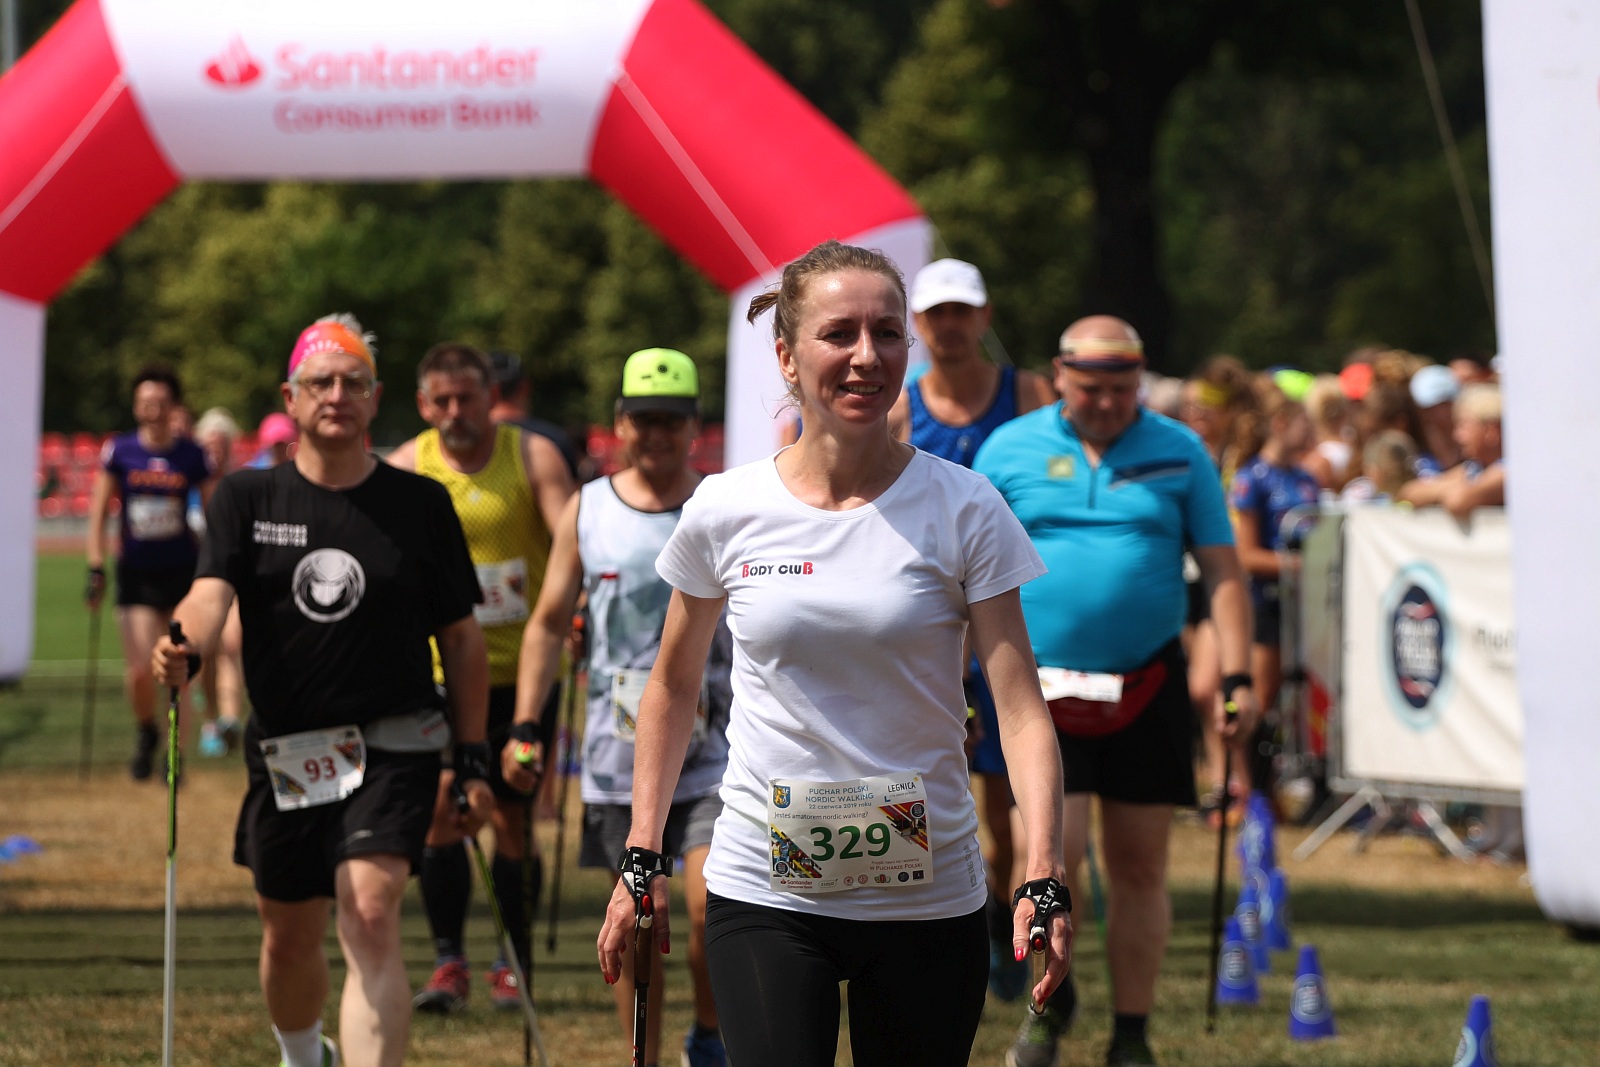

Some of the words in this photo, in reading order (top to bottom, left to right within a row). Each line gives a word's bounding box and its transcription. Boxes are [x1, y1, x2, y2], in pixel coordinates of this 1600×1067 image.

[274, 42, 540, 90] Santander
[273, 99, 447, 132] Consumer
[452, 98, 539, 131] Bank
[303, 756, 337, 783] 93
[838, 793, 874, 802] WALKING
[843, 785, 869, 794] POLSKI
[887, 782, 917, 793] LEGNICA
[843, 812, 869, 820] walking?
[810, 822, 891, 862] 329
[632, 852, 646, 894] LEKI
[1039, 880, 1058, 910] LEKI
